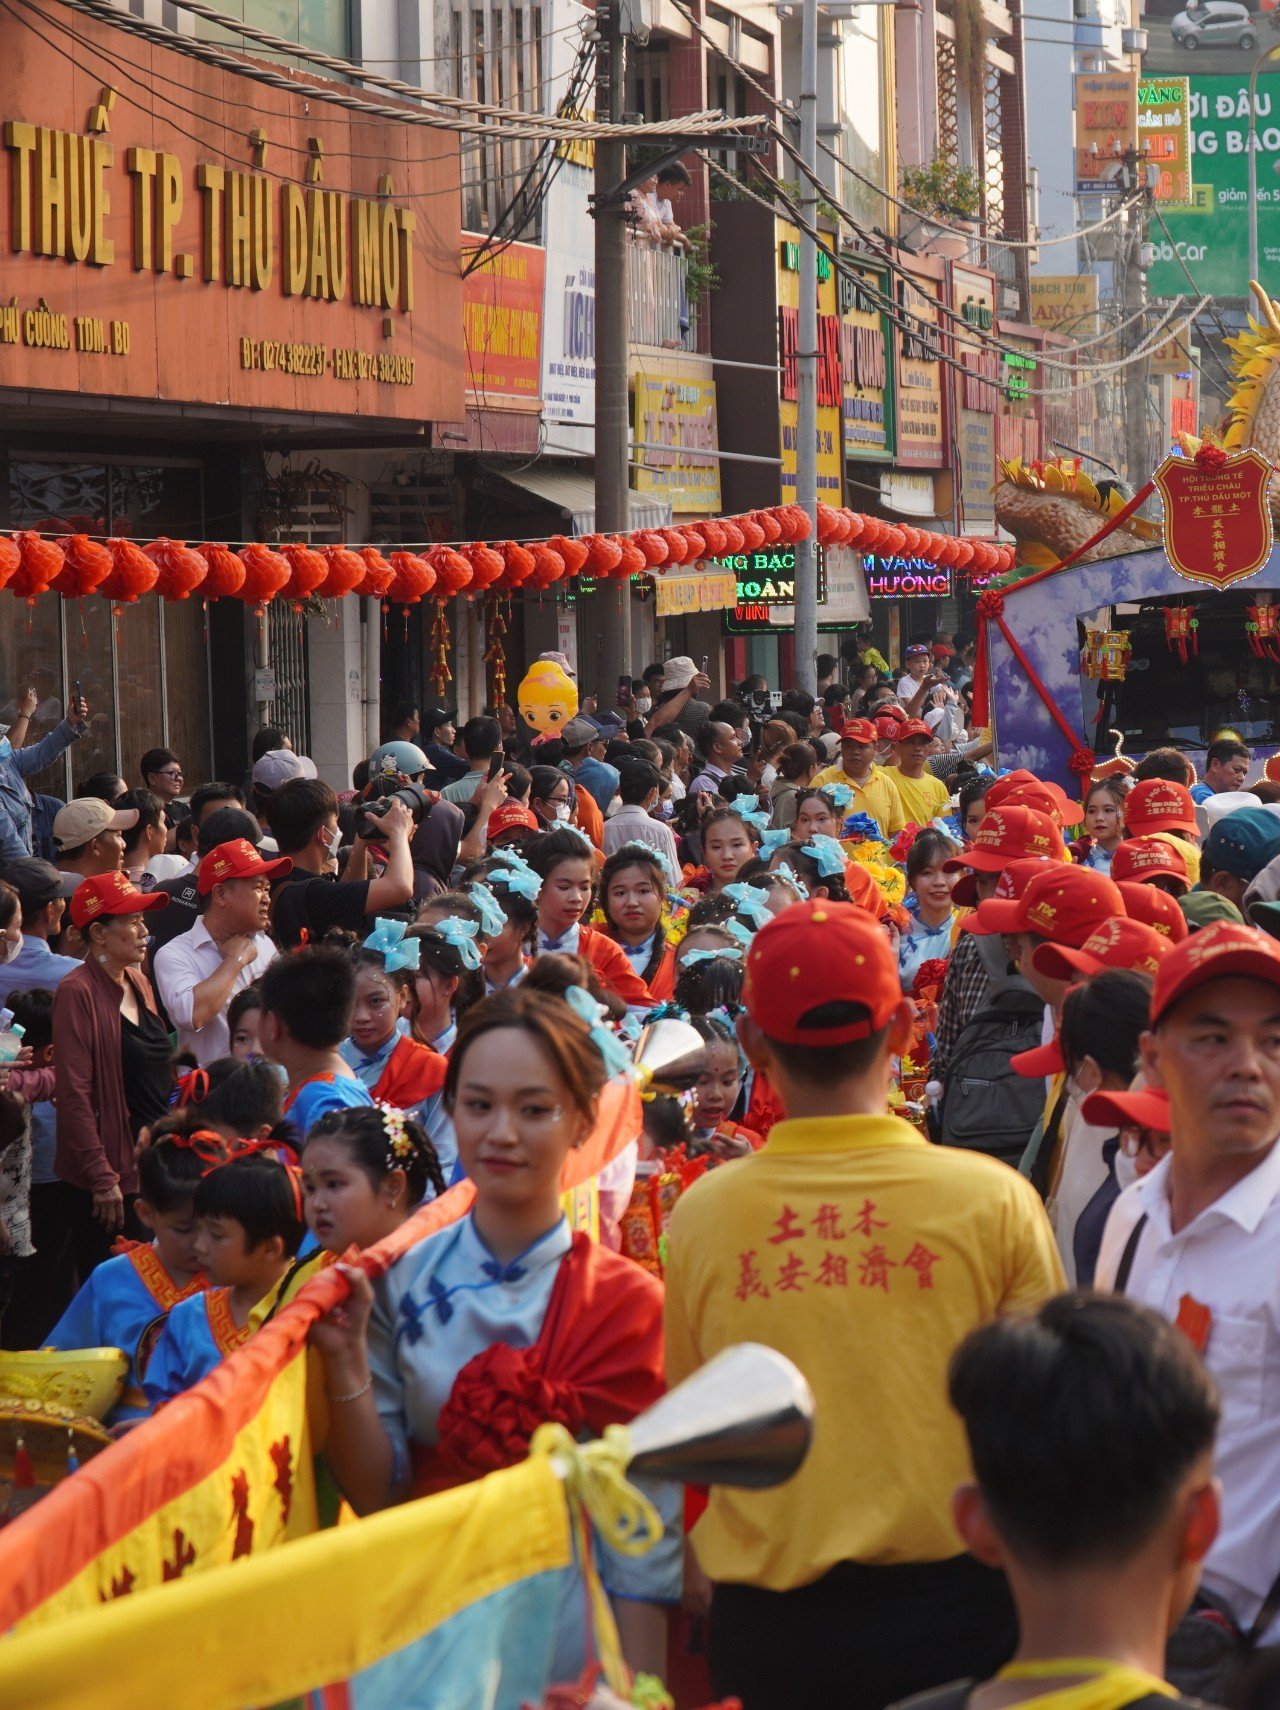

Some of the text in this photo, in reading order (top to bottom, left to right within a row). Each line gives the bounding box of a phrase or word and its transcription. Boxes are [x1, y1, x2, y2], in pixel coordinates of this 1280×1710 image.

[1137, 83, 1183, 106] VÀNG
[1216, 88, 1273, 119] ĐÂU
[1218, 187, 1247, 203] giảm
[1256, 188, 1271, 201] ến
[5, 86, 416, 338] THUẾ TP. THỦ DẦU MỘT
[110, 320, 130, 356] BD
[1216, 482, 1241, 491] CHÂU
[1212, 492, 1231, 501] DẦU
[1232, 491, 1252, 501] MỘT
[754, 554, 796, 572] BẠC
[1032, 834, 1050, 846] TDC
[170, 894, 198, 910] ROMANO
[1036, 901, 1057, 918] TDC
[1152, 922, 1171, 935] TDC
